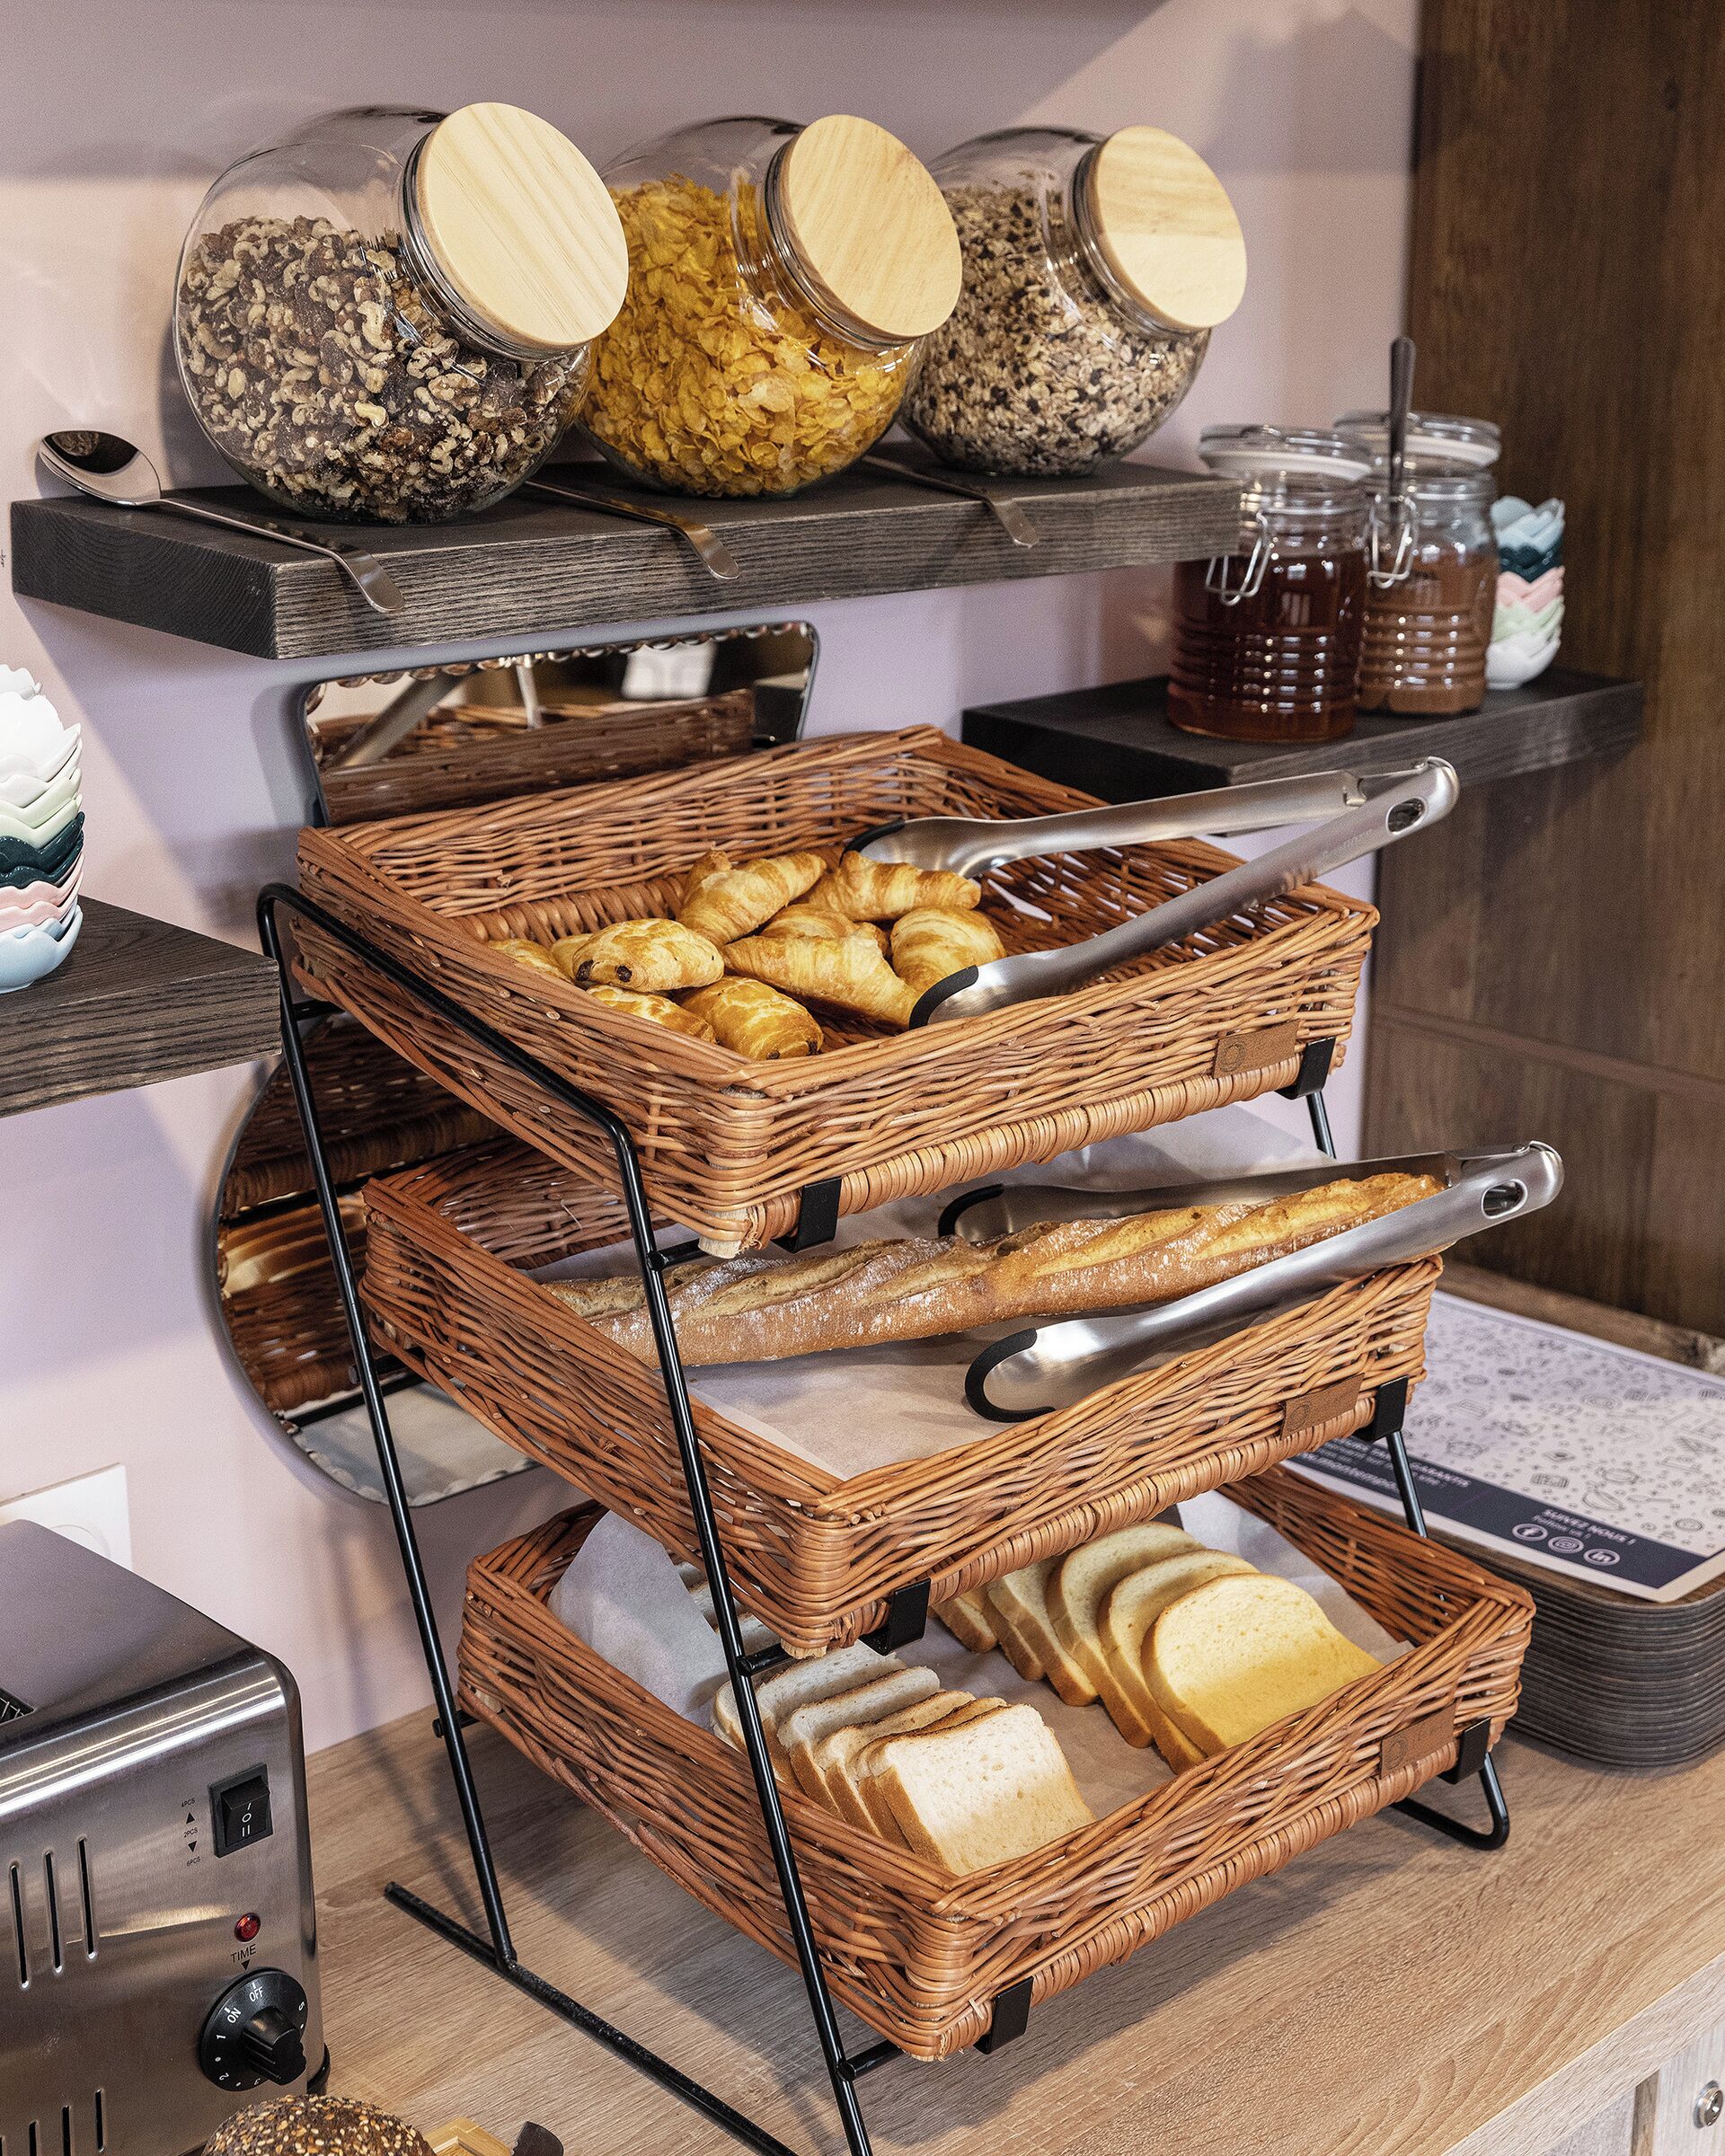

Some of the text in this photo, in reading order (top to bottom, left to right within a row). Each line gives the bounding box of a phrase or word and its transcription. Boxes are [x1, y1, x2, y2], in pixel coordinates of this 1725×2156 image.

[1542, 1508, 1589, 1529] SUIVEZ
[1588, 1524, 1629, 1543] NOUS
[181, 1798, 196, 1807] 4PCS
[182, 1826, 198, 1838] 2PCS
[230, 1943, 257, 1964] TIME
[249, 1986, 264, 2002] OFF
[226, 2007, 242, 2024] ON
[218, 2072, 229, 2081] 2
[253, 2077, 261, 2086] 3
